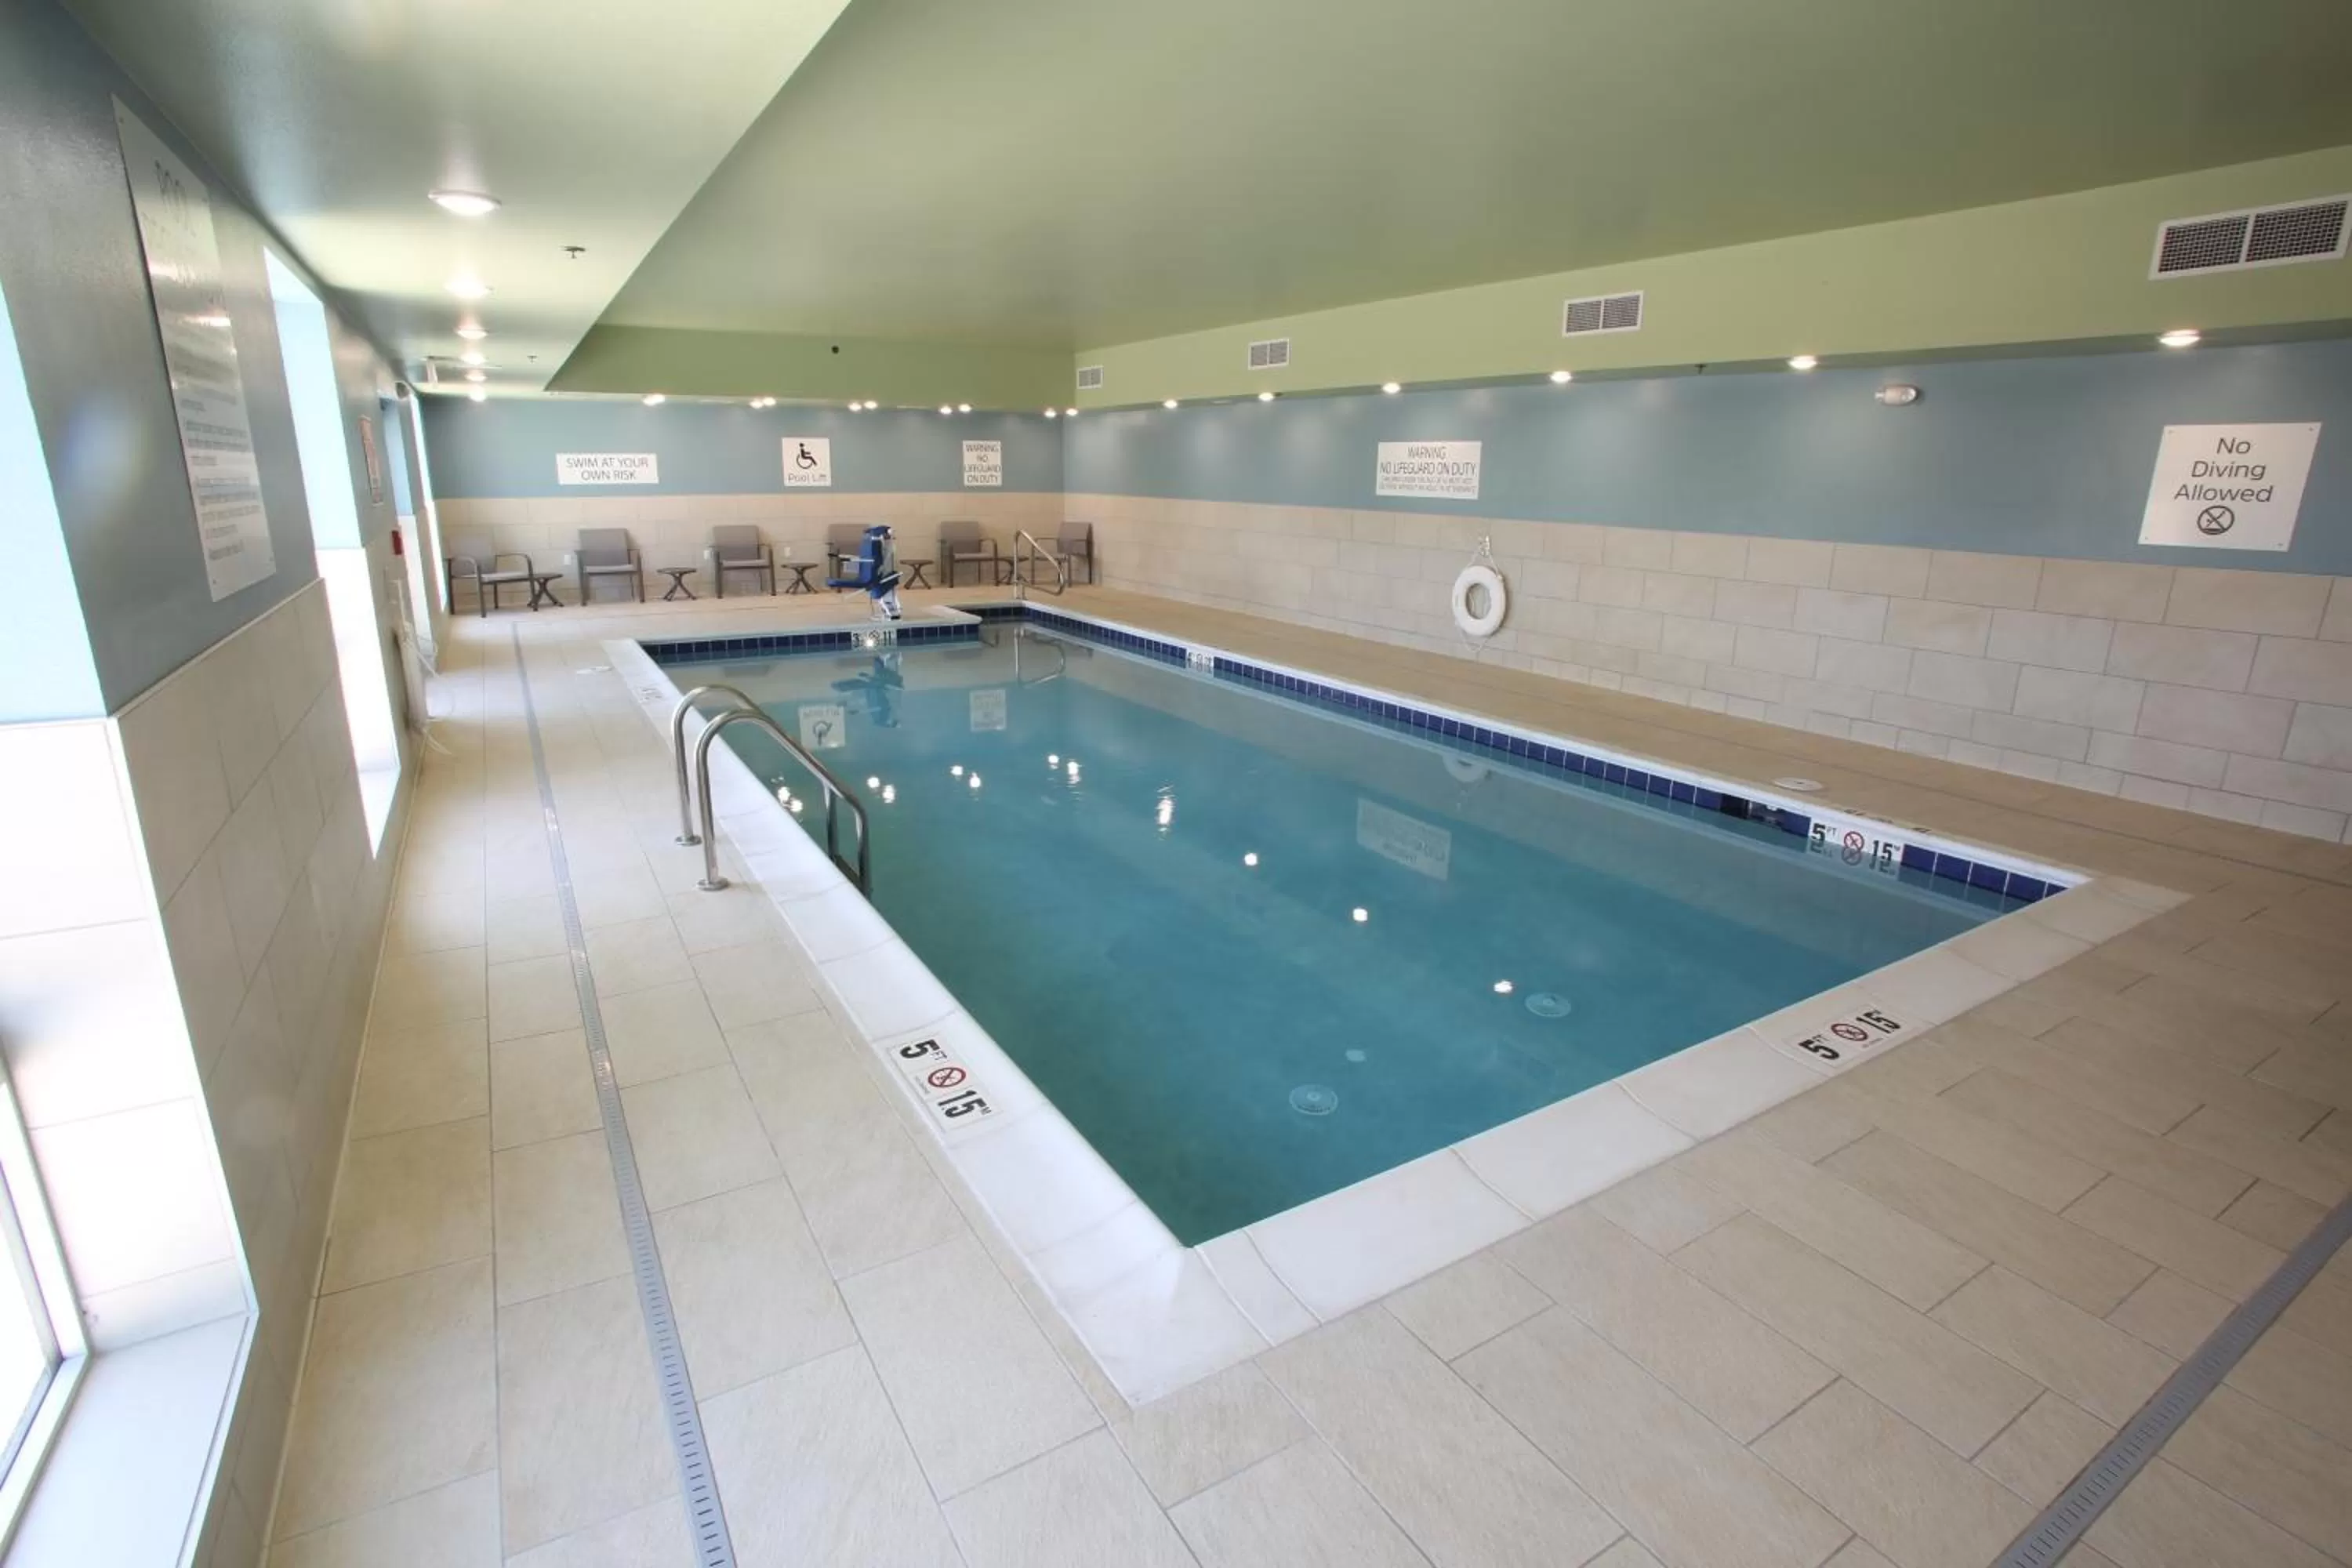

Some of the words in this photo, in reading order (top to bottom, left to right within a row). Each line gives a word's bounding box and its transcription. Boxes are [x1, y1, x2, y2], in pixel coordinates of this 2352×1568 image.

[2216, 437, 2252, 455] No
[565, 457, 598, 468] SWIM
[601, 457, 615, 468] AT
[617, 457, 649, 468] YOUR
[1380, 461, 1392, 474] NO
[1437, 462, 1450, 475] ON
[1451, 462, 1477, 476] DUTY
[2190, 459, 2267, 481] Diving
[581, 470, 612, 481] OWN
[614, 470, 636, 481] RISK
[2173, 484, 2274, 503] Allowed
